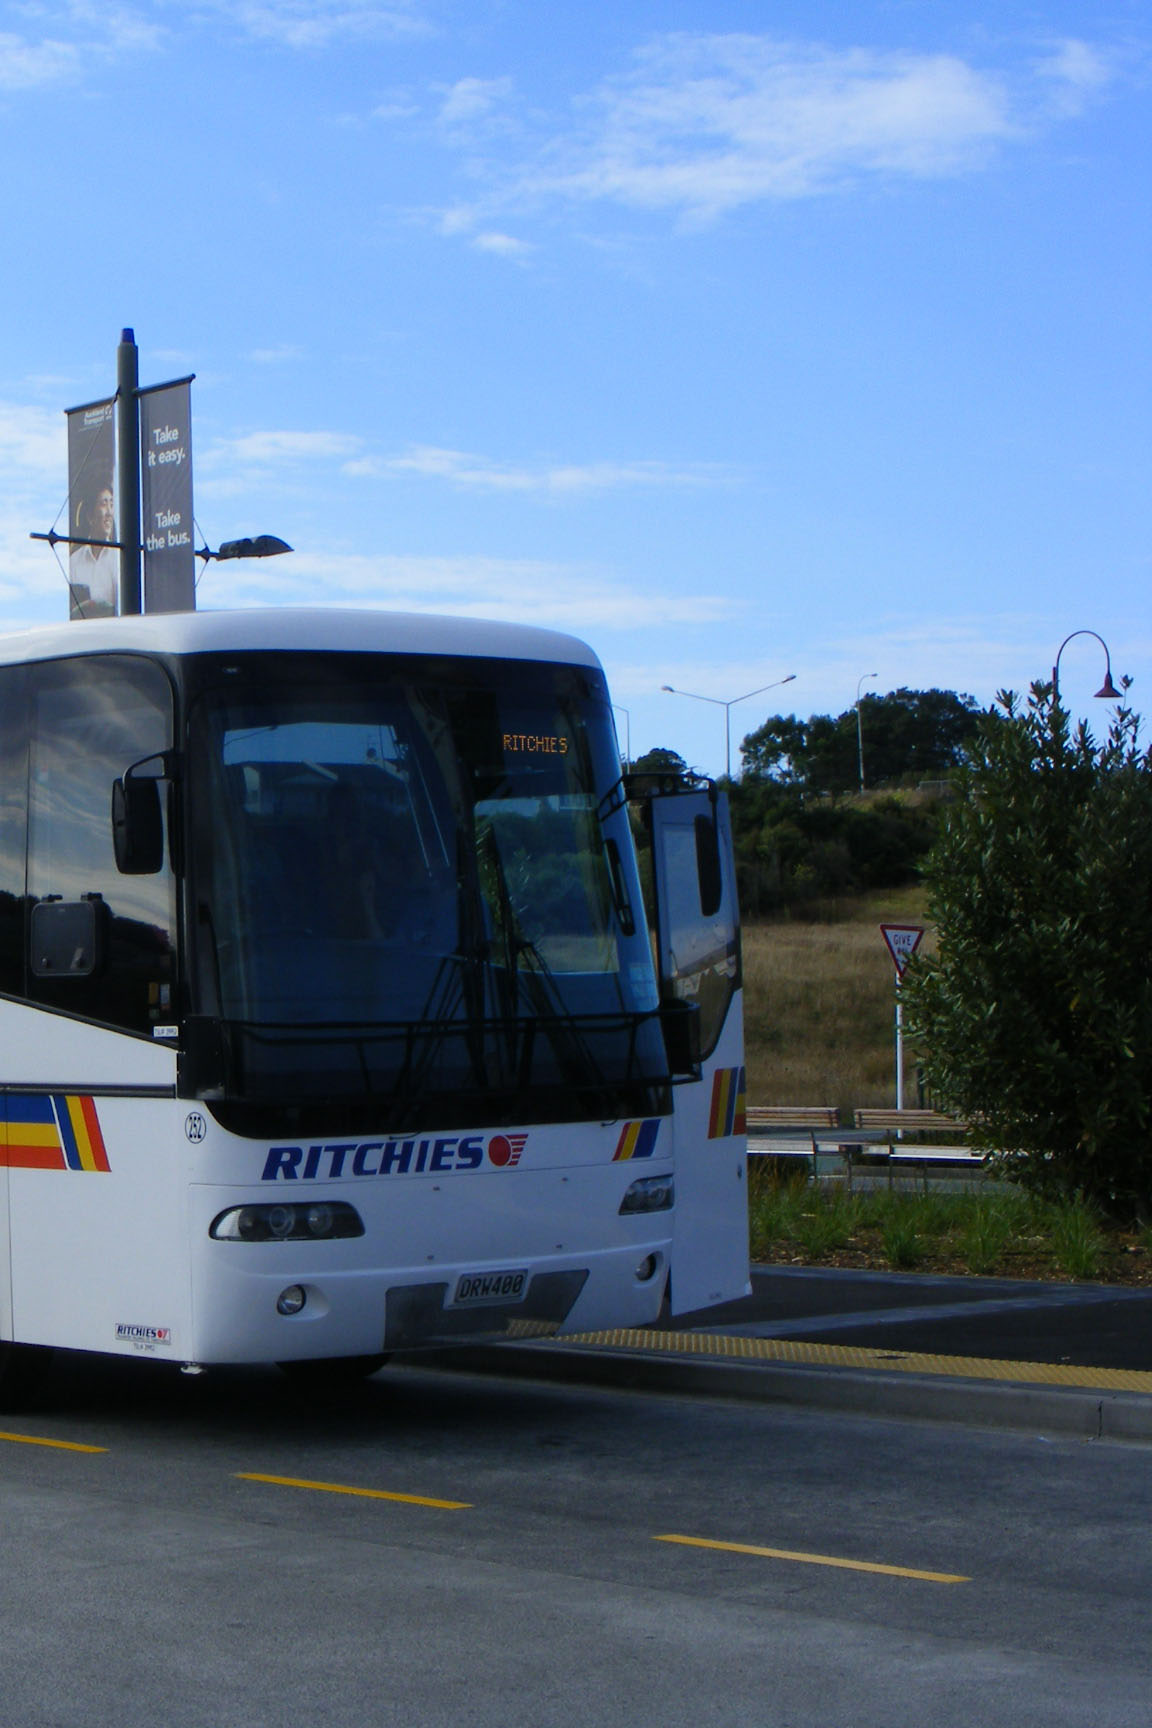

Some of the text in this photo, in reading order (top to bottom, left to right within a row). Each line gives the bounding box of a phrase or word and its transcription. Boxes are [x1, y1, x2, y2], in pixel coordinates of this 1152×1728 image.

[152, 424, 179, 445] Take
[148, 447, 186, 467] it easy.
[154, 508, 181, 528] Take
[146, 529, 190, 551] the bus.
[503, 734, 568, 753] RITCHIES
[893, 934, 911, 946] GIVE
[188, 1116, 202, 1138] 252
[261, 1136, 484, 1181] RITCHIES
[117, 1324, 157, 1338] RITCHIES
